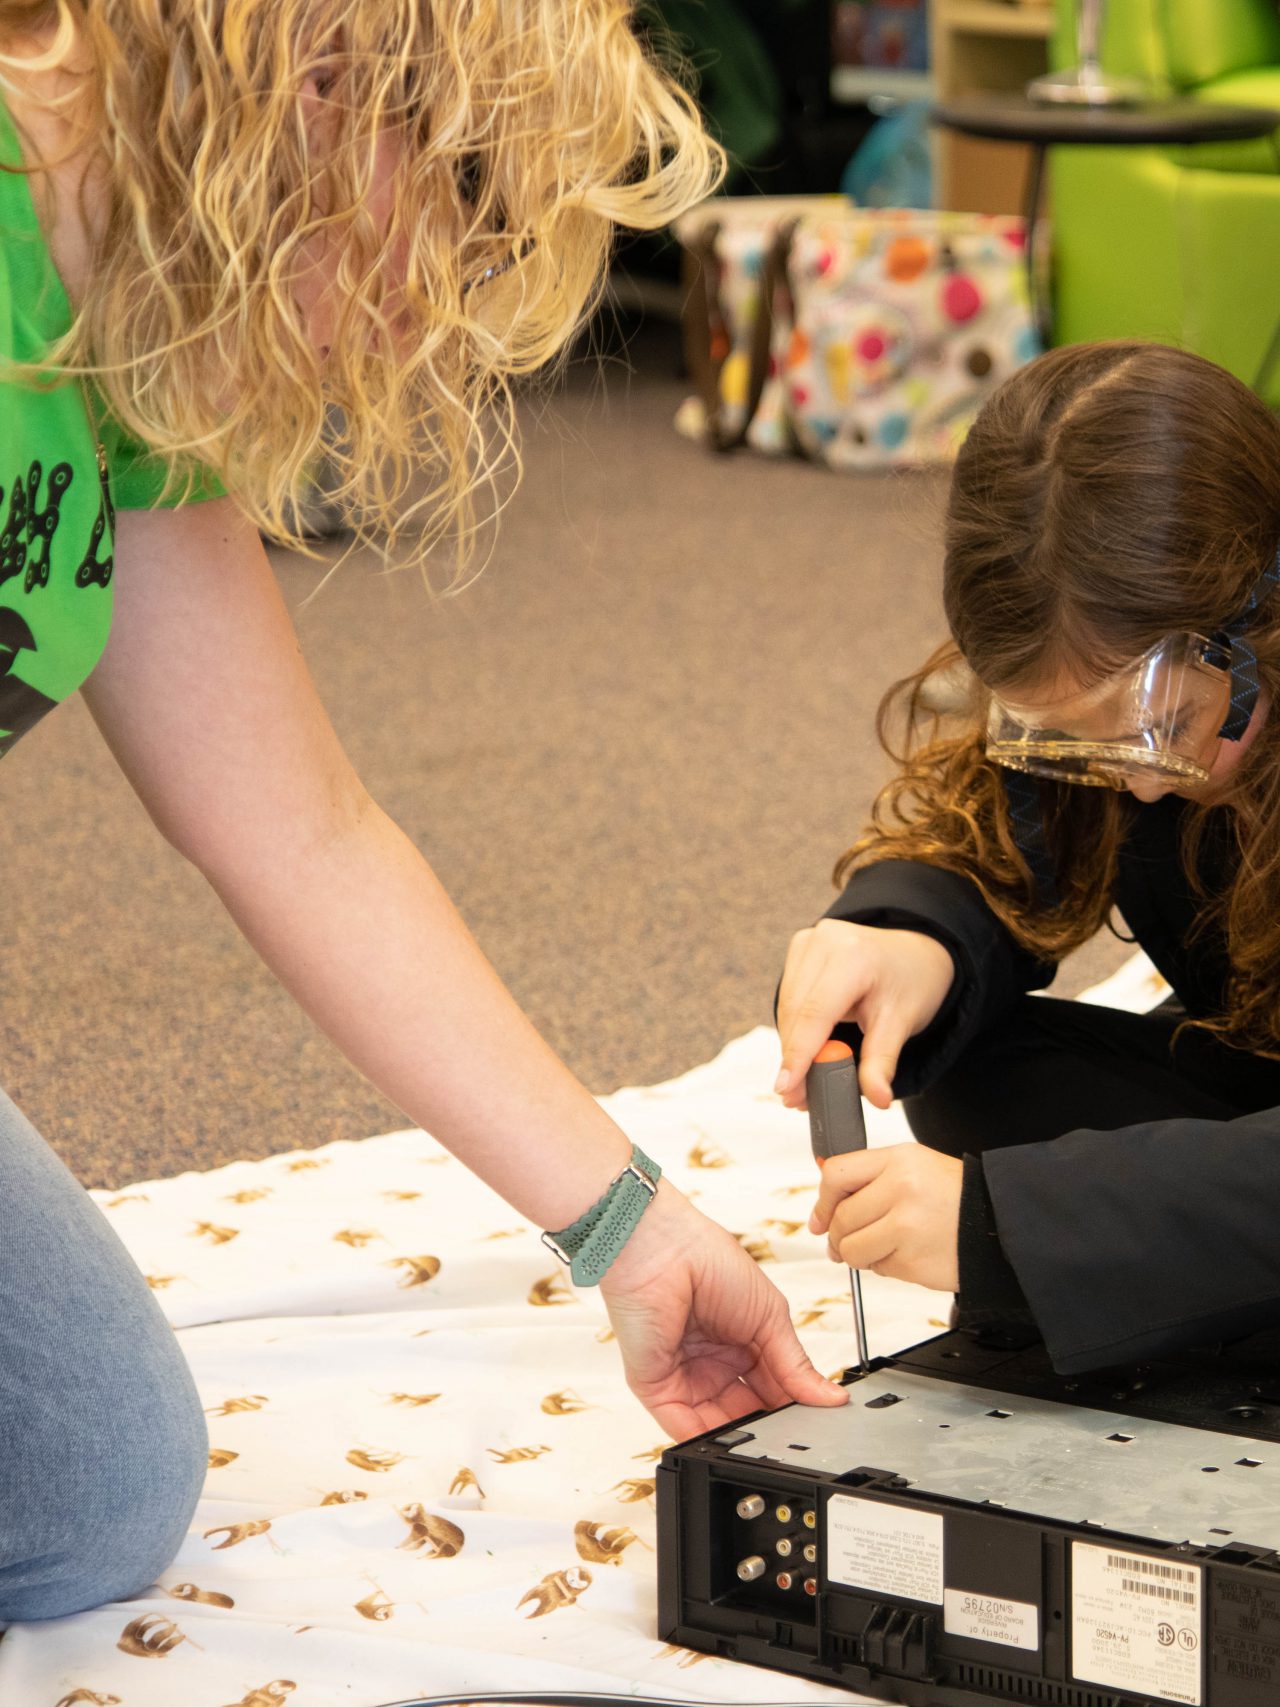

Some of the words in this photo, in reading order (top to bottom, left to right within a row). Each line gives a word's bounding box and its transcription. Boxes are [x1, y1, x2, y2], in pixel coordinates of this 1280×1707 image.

[960, 1607, 993, 1618] EDUCATION
[1003, 1615, 1023, 1624] BOARD
[981, 1626, 1018, 1643] Property
[1095, 1627, 1128, 1643] PV-V4520
[1227, 1659, 1270, 1680] CAUTION
[1159, 1689, 1195, 1703] Panasonic
